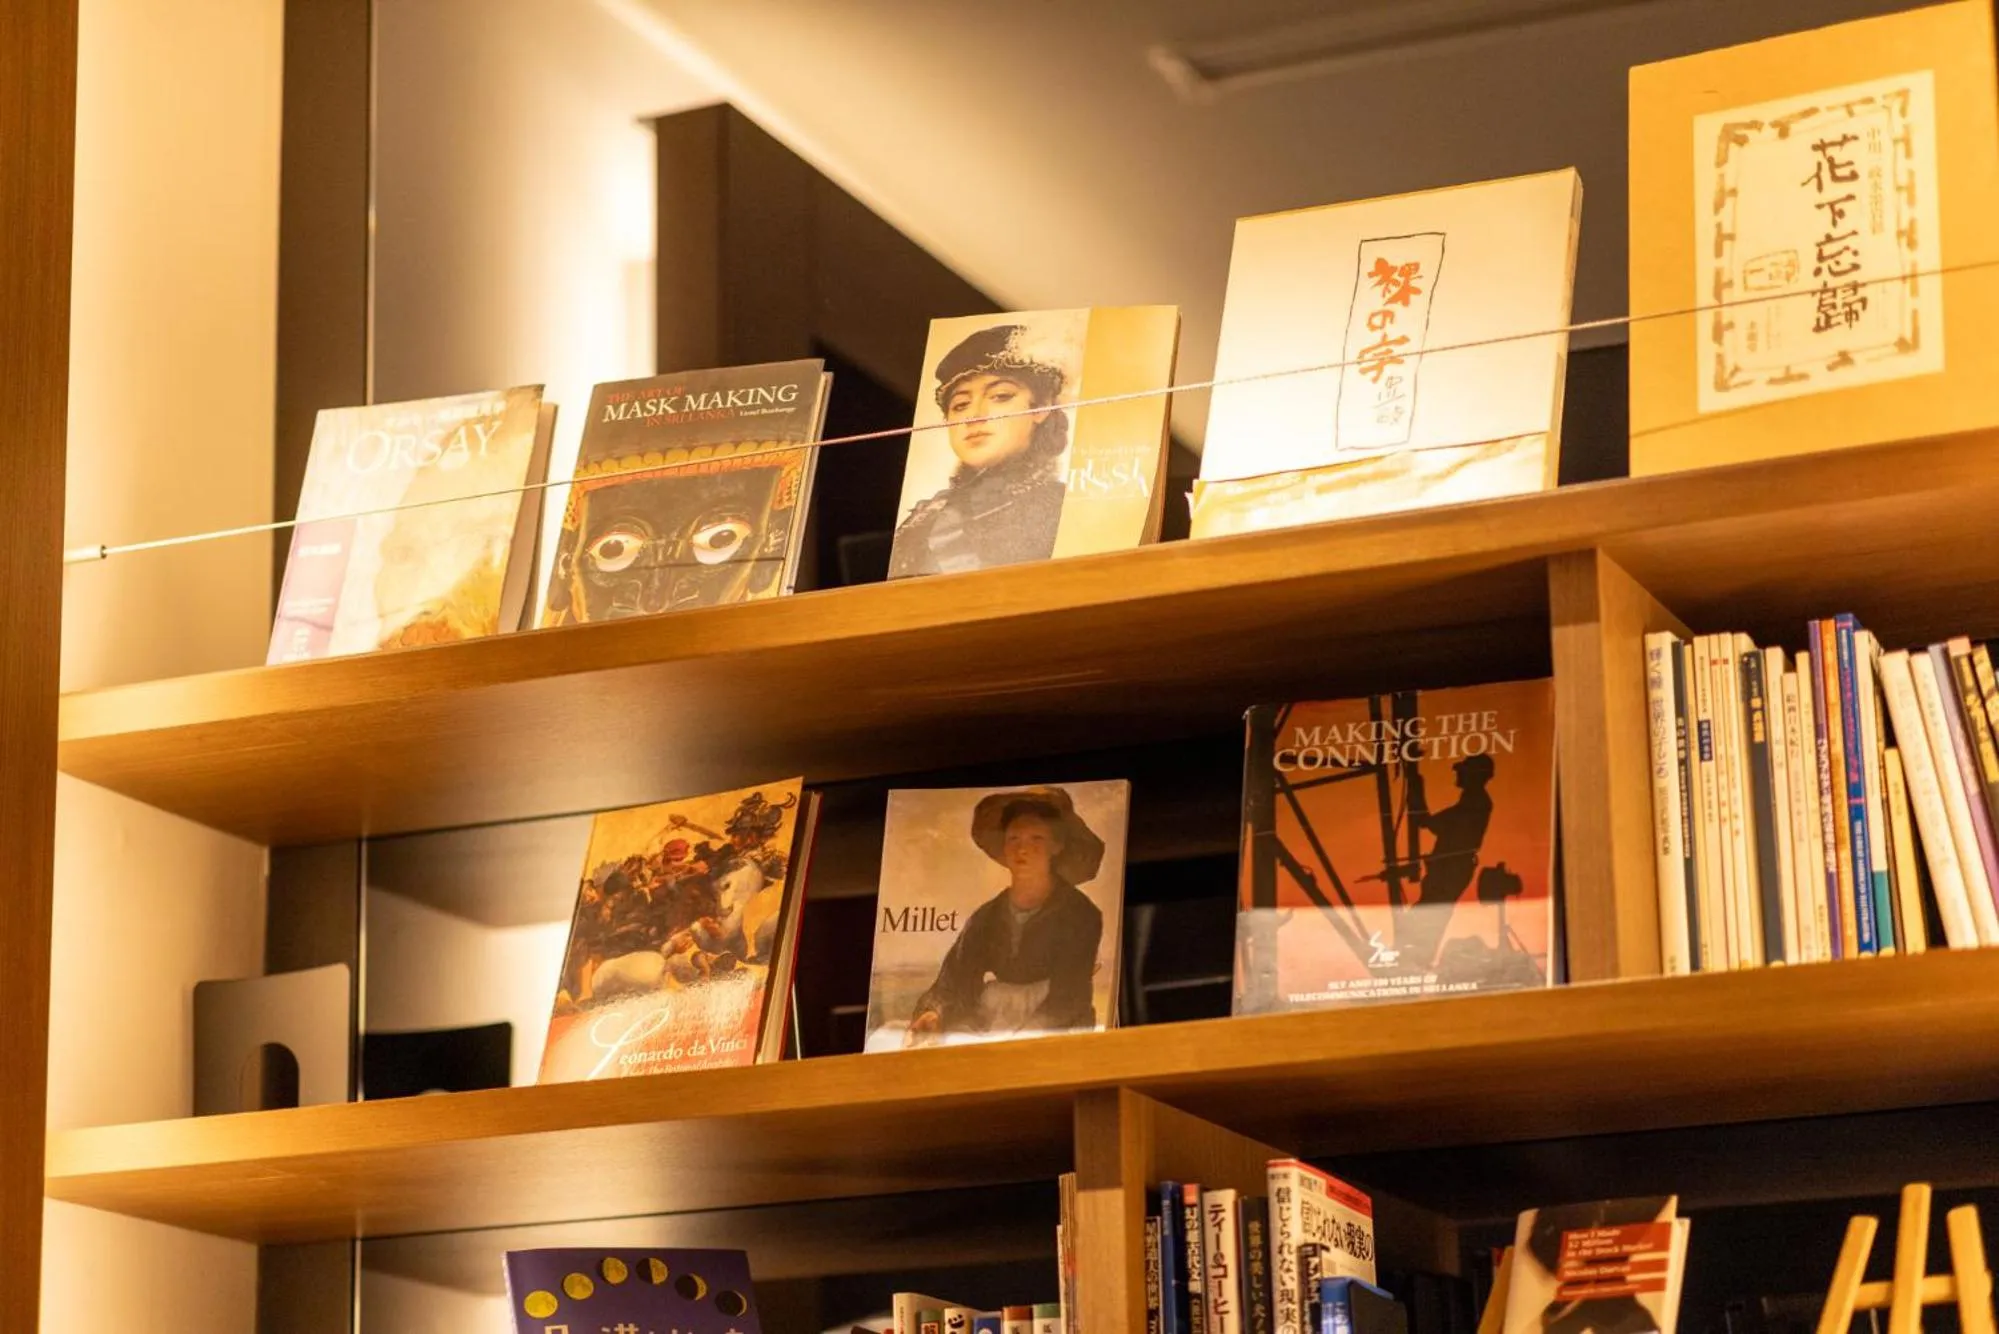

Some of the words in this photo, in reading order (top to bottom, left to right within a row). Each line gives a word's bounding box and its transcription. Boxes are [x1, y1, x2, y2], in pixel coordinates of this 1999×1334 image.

[602, 396, 679, 422] MASK
[682, 384, 799, 412] MAKING
[347, 421, 502, 474] ORSAY
[1293, 717, 1426, 747] MAKING
[1436, 710, 1498, 735] THE
[1273, 729, 1519, 772] CONNECTION
[881, 906, 959, 933] Millet
[687, 1044, 706, 1058] da
[709, 1036, 748, 1055] Vinci
